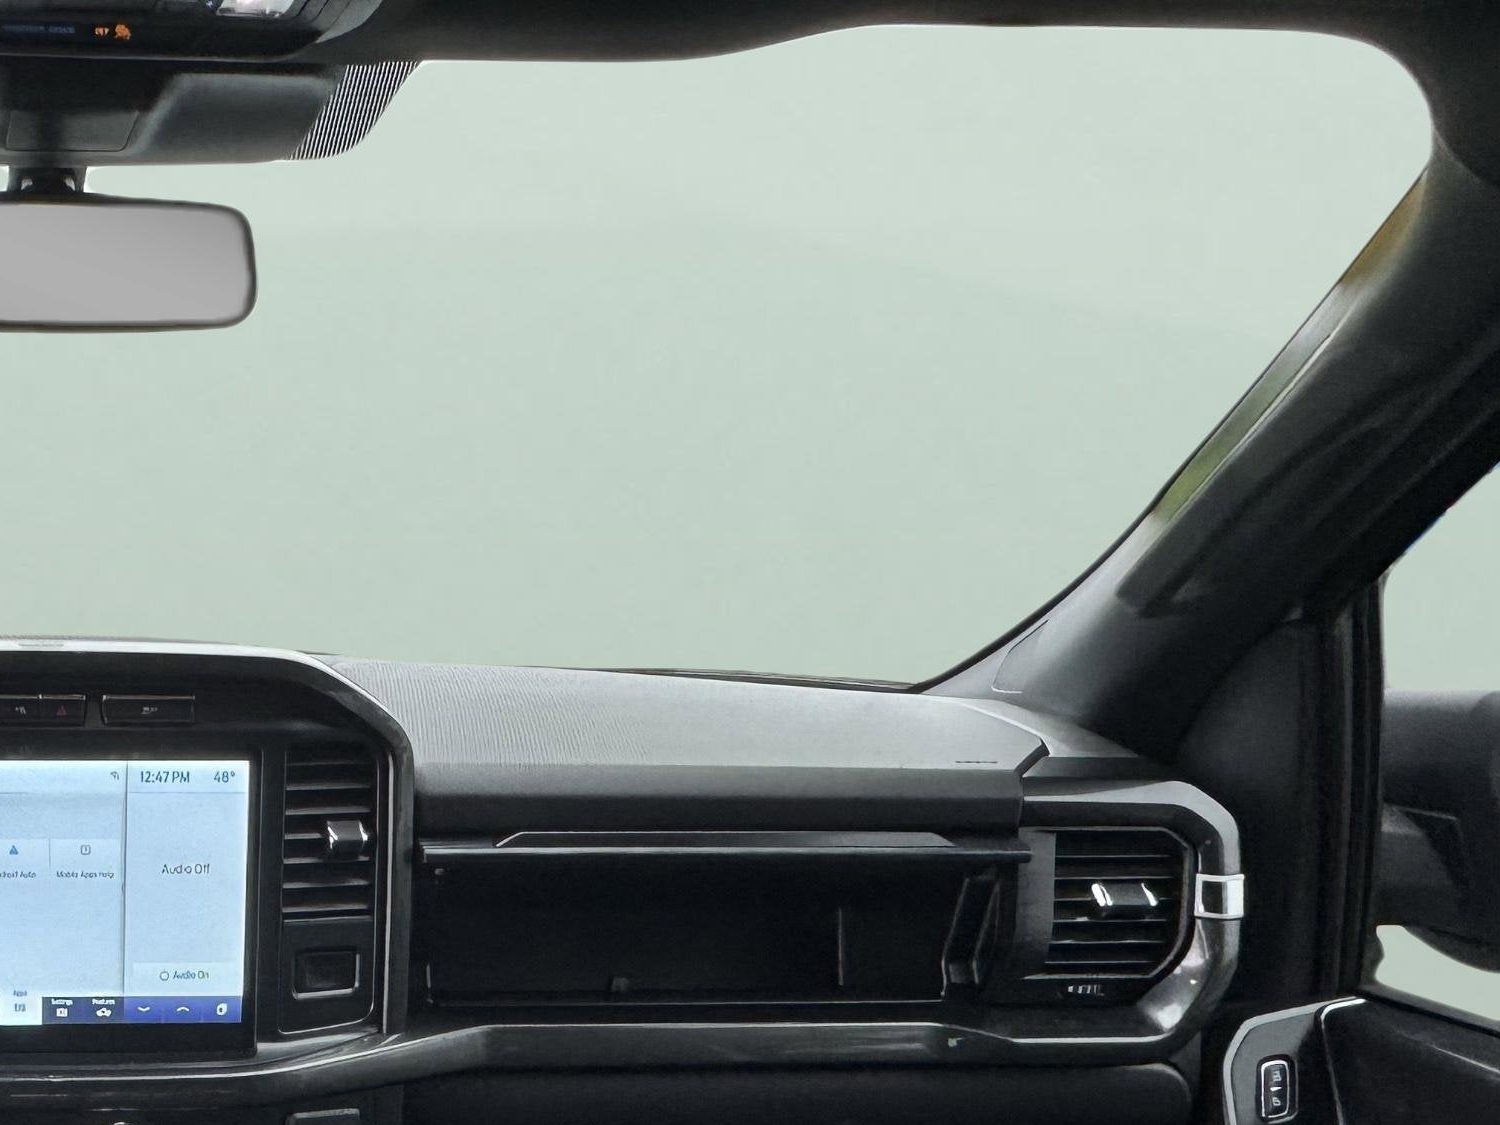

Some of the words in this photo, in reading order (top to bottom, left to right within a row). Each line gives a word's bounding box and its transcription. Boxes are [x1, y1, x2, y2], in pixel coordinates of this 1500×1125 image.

[140, 771, 169, 783] 12:47
[172, 771, 190, 783] PM
[214, 771, 236, 783] 48°
[161, 864, 192, 875] Audio
[194, 863, 211, 874] Off
